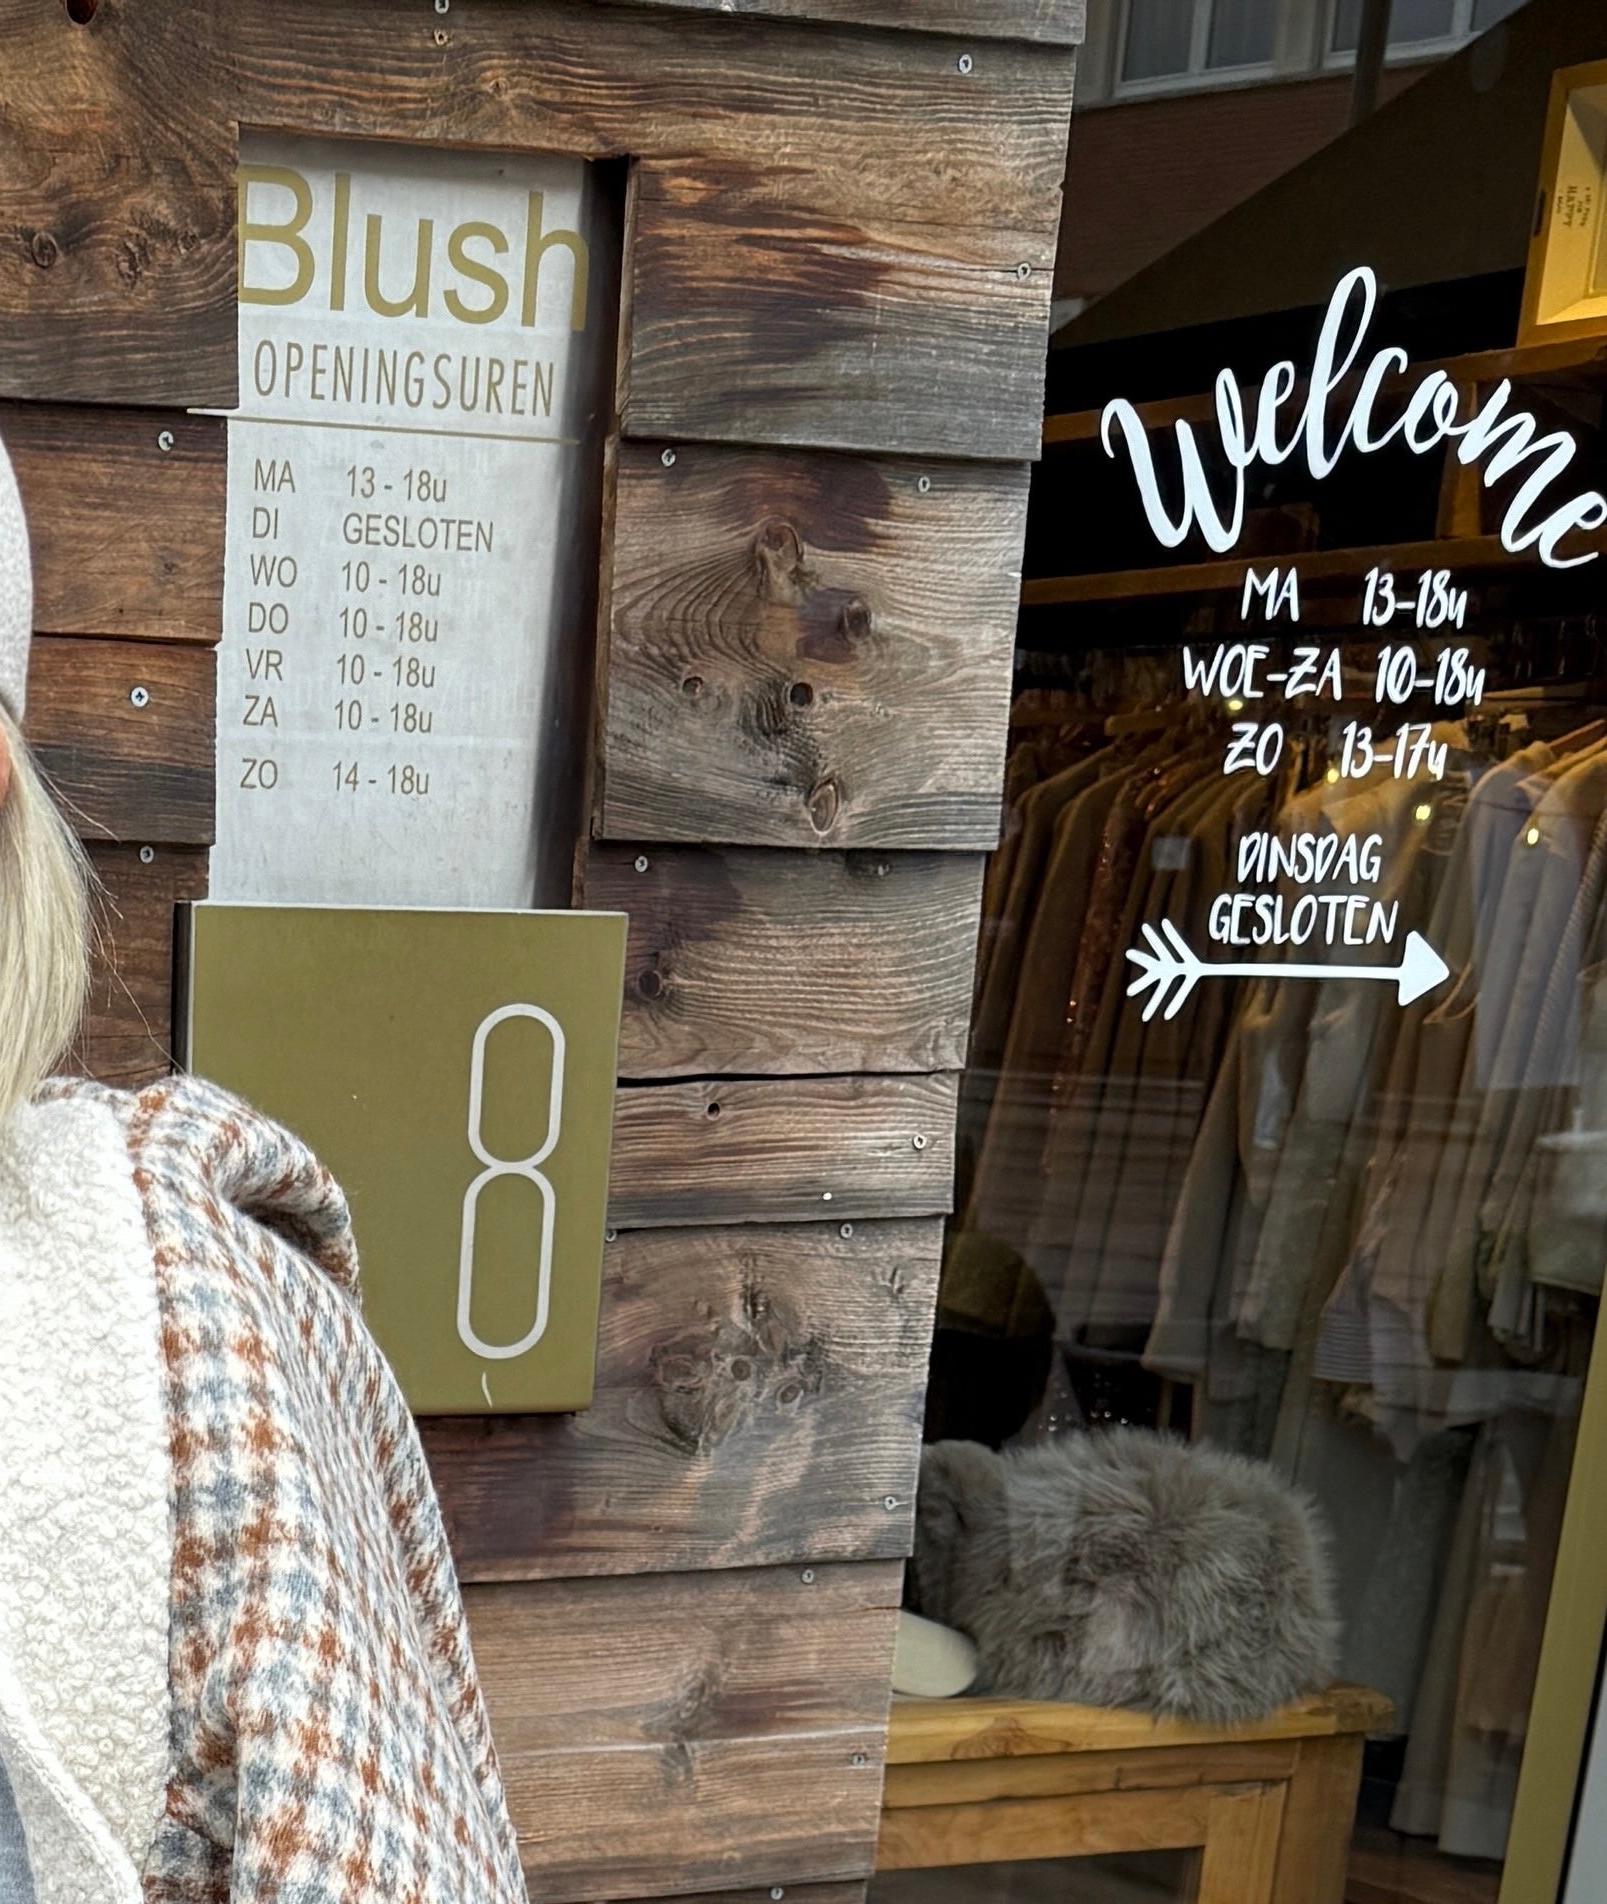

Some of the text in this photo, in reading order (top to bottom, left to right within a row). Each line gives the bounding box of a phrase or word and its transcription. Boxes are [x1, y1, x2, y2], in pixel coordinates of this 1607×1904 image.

[237, 165, 590, 333] Blush
[253, 339, 555, 418] OPENINGSUREN
[1100, 265, 1607, 569] Welcome
[254, 458, 297, 494] MA
[347, 464, 376, 502] 13
[403, 467, 448, 504] 18u
[252, 506, 494, 553] DI GESLOTEN
[250, 553, 298, 589] WO
[341, 559, 370, 596] 10
[397, 563, 442, 597] 18u
[1241, 567, 1468, 629] MA 13-18u
[248, 601, 289, 635] DO
[338, 606, 368, 640] 10
[395, 610, 439, 643] 18u
[245, 647, 283, 682] VR
[336, 653, 365, 686] 10
[392, 655, 436, 689] 18u
[1183, 643, 1486, 706] WOE-ZA 10-18u
[242, 694, 279, 728] ZA
[334, 698, 363, 731] 10
[390, 701, 433, 734] 18u
[1223, 722, 1284, 776] ZO
[239, 757, 279, 790] ZO
[332, 760, 360, 793] 14
[387, 763, 430, 796] 18u
[1237, 831, 1383, 885] DINSDAG
[1208, 893, 1399, 947] GESLOTEN
[456, 1001, 567, 1360] 8
